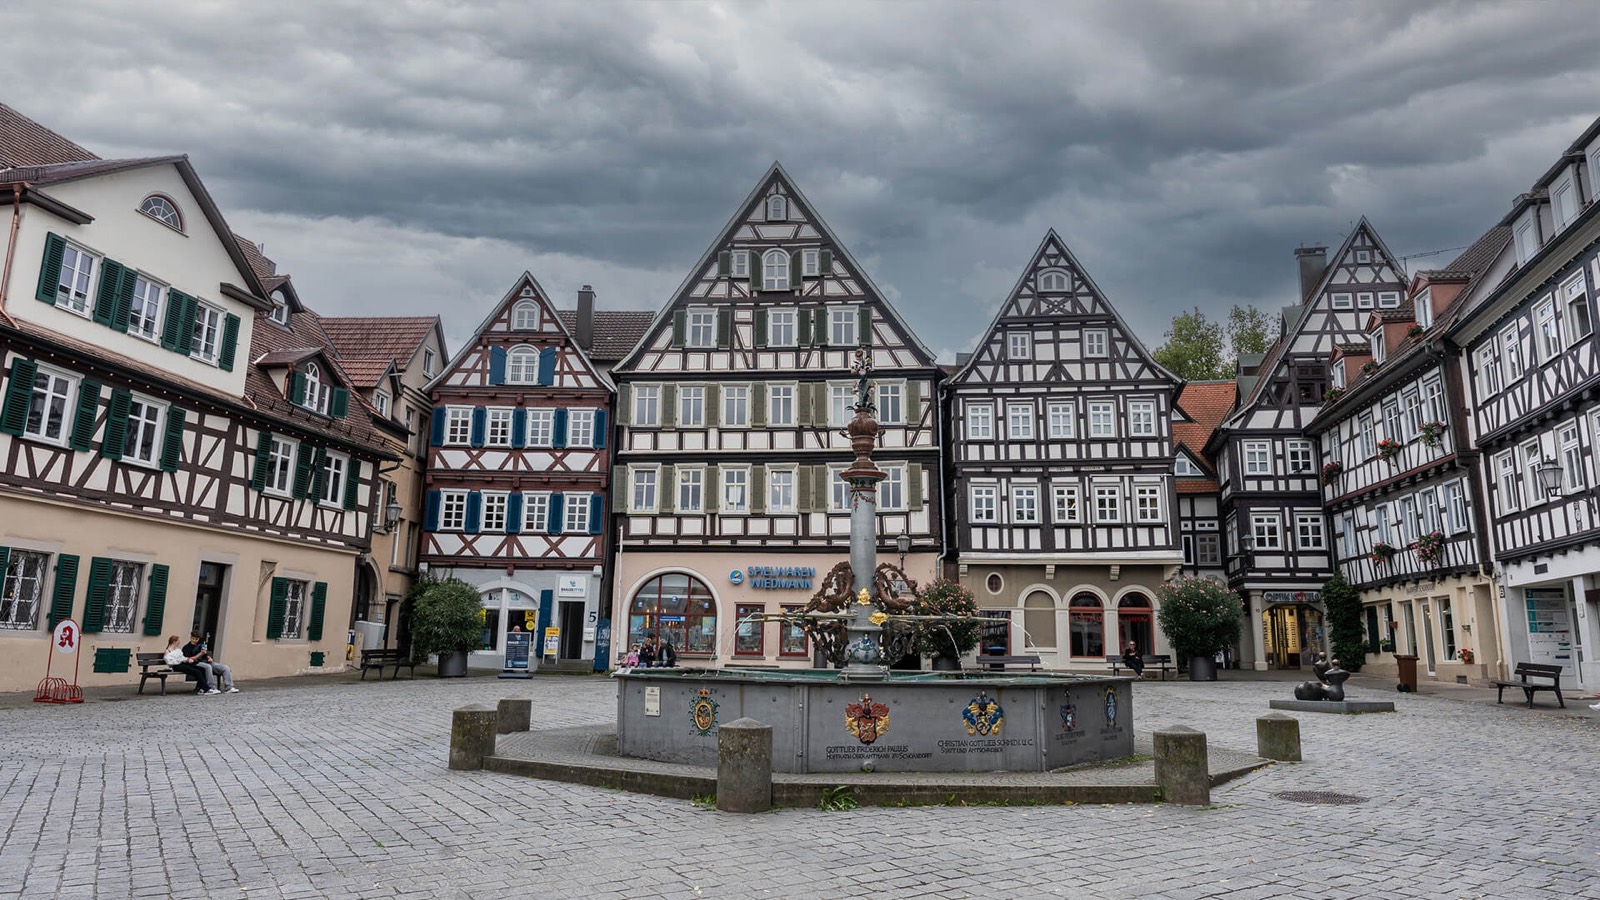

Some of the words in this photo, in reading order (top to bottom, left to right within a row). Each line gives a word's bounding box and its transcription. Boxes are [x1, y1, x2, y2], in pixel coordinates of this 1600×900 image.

[747, 566, 816, 578] SPIELWAREN
[749, 578, 813, 590] WIEDMANN
[589, 611, 598, 623] 5
[826, 745, 856, 753] GOTTLIEB
[969, 739, 996, 747] GOTTLIEB
